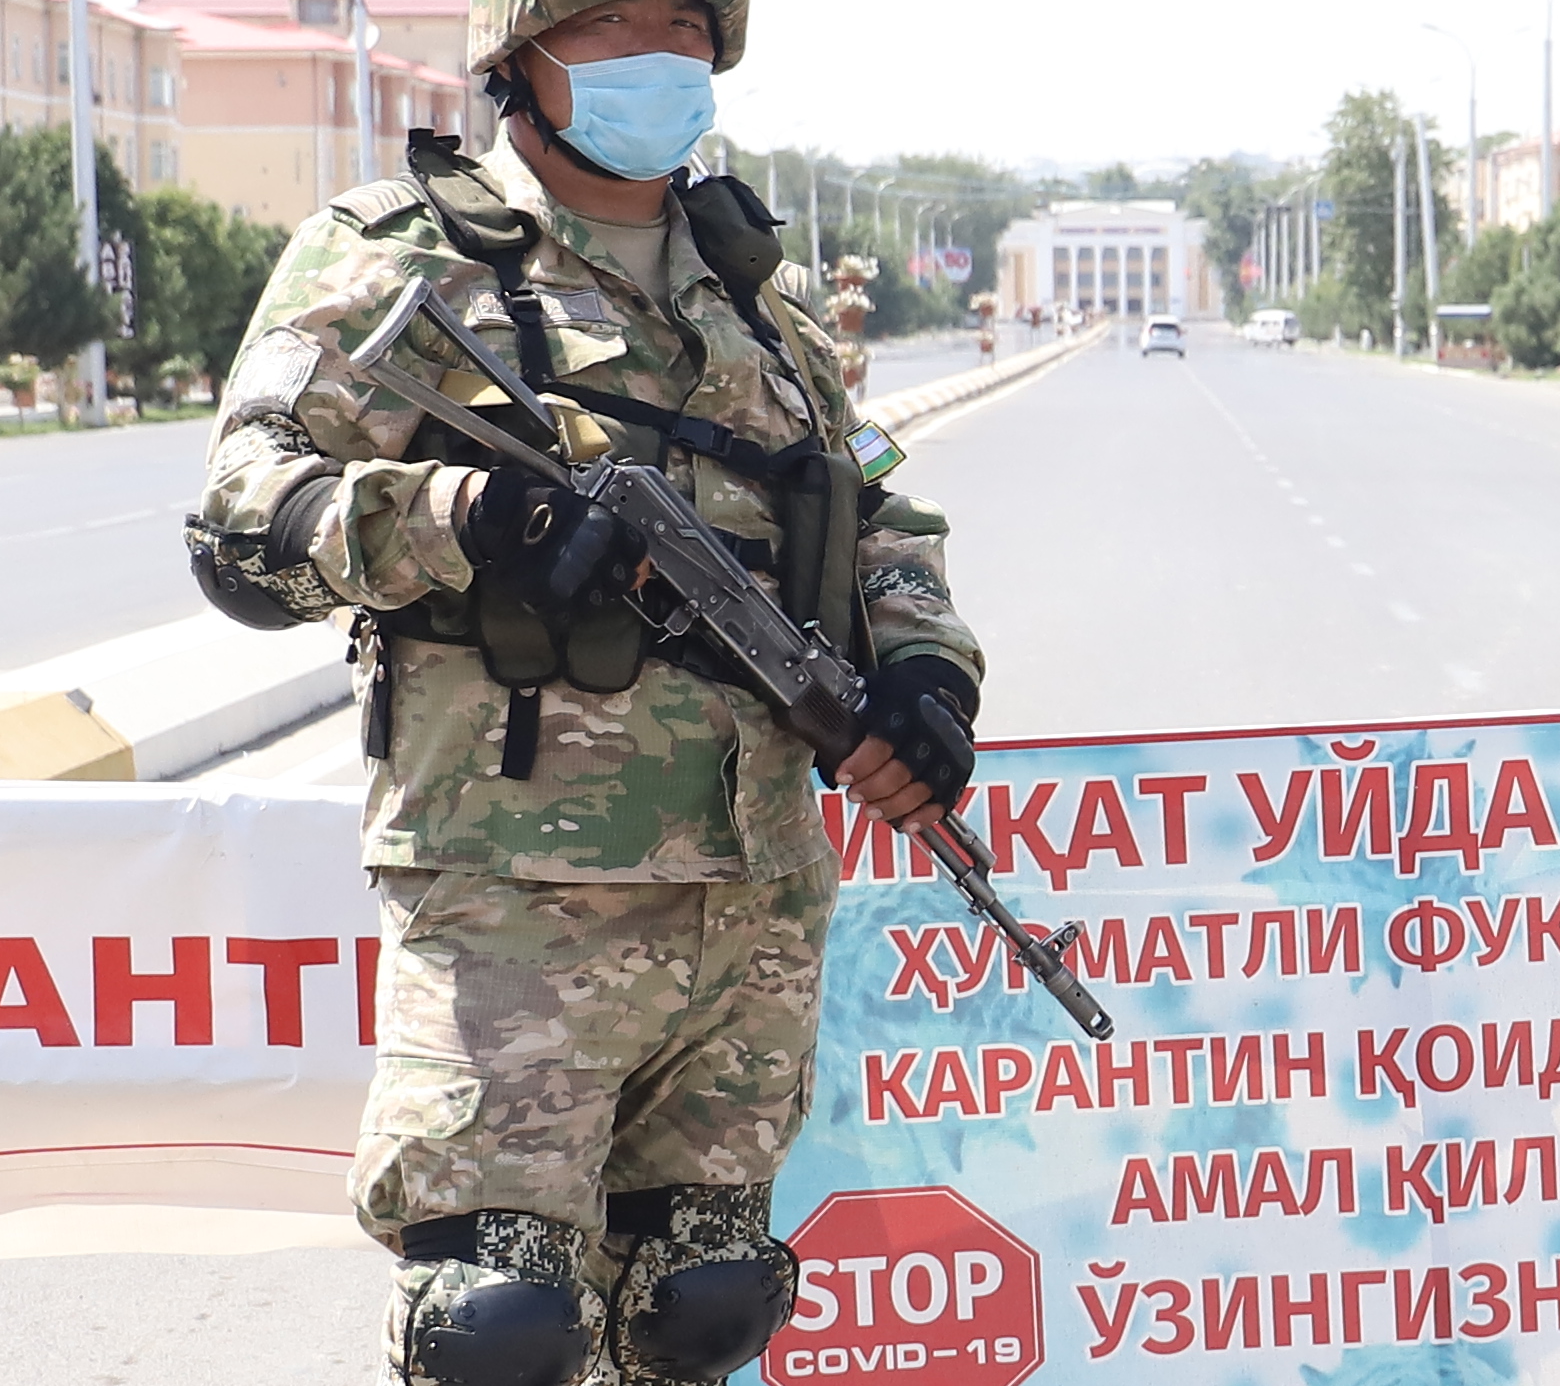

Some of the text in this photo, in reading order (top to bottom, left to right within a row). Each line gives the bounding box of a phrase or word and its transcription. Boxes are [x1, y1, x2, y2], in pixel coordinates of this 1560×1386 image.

[1238, 740, 1557, 874] УЙДА
[867, 1032, 1327, 1121] КАРАНТИН
[1113, 1148, 1356, 1224] АМАЛ
[791, 1250, 1004, 1332] STOP
[785, 1336, 1022, 1377] COVID-19
